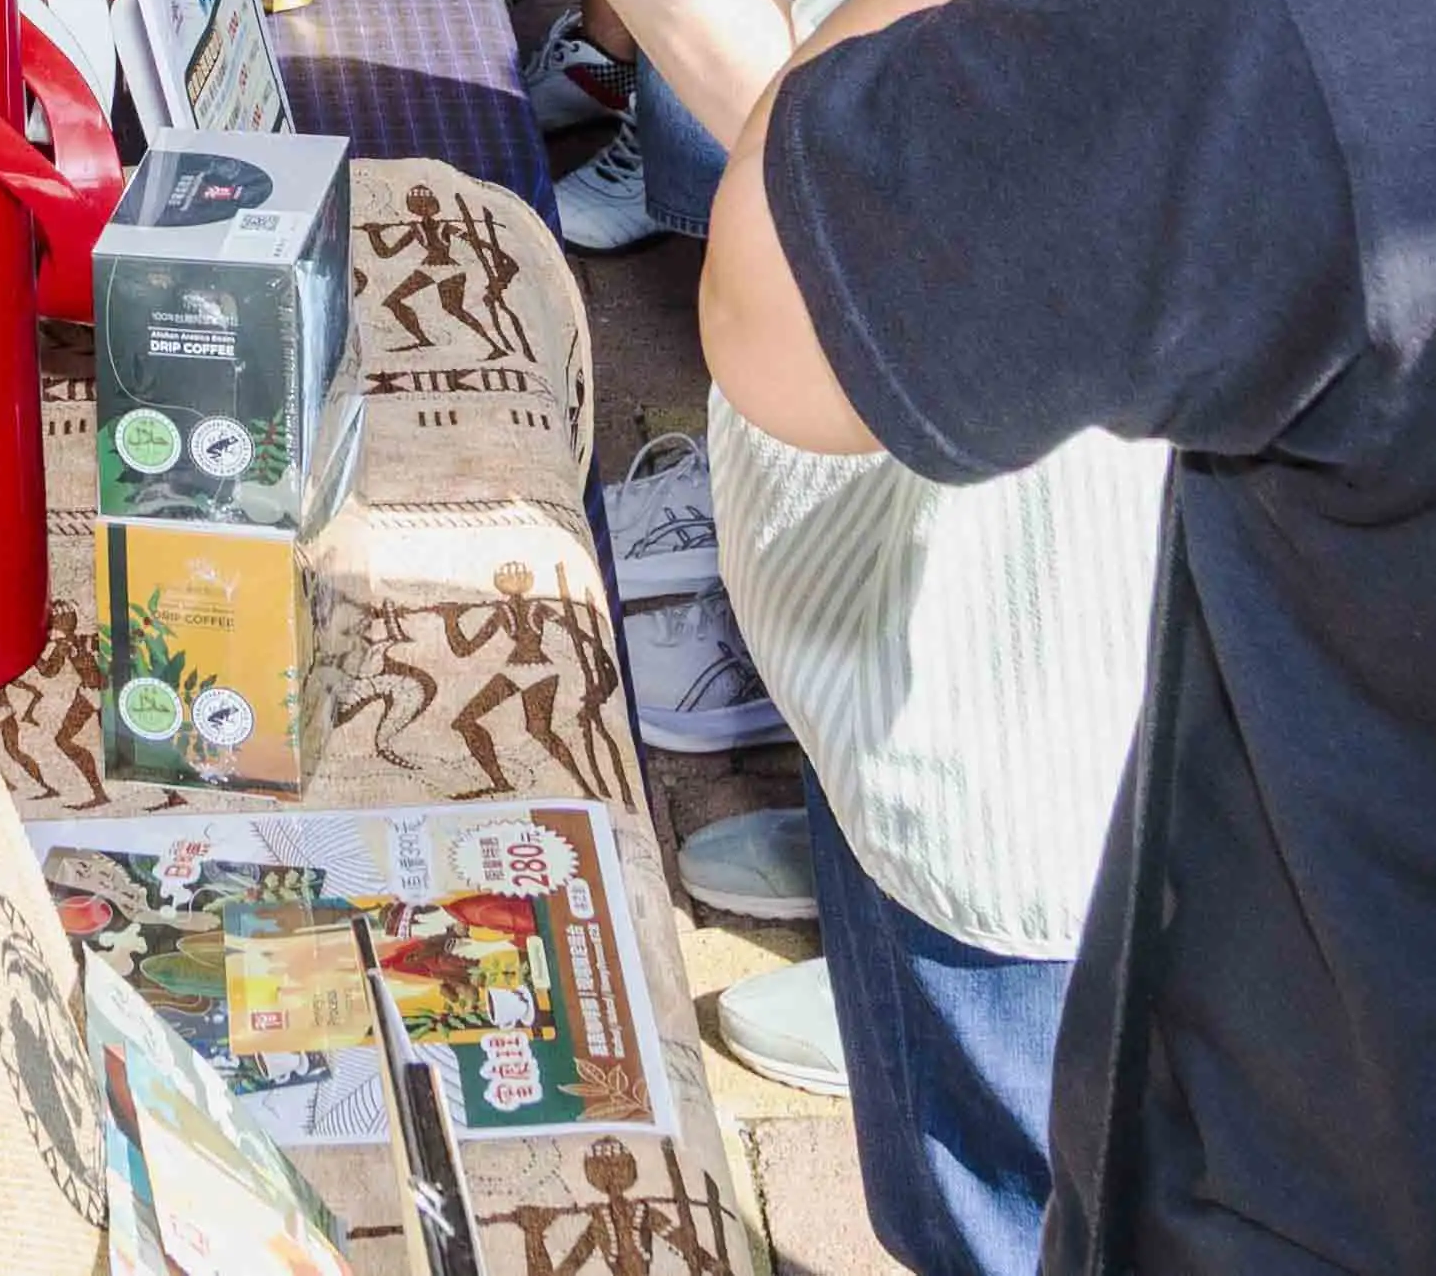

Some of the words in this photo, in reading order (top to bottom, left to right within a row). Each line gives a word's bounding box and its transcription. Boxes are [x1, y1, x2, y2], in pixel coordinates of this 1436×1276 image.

[150, 339, 182, 353] DRIP
[183, 342, 235, 356] COFFEE
[153, 610, 181, 622] DRIP
[184, 614, 235, 628] COFFEE
[509, 829, 549, 894] 280元
